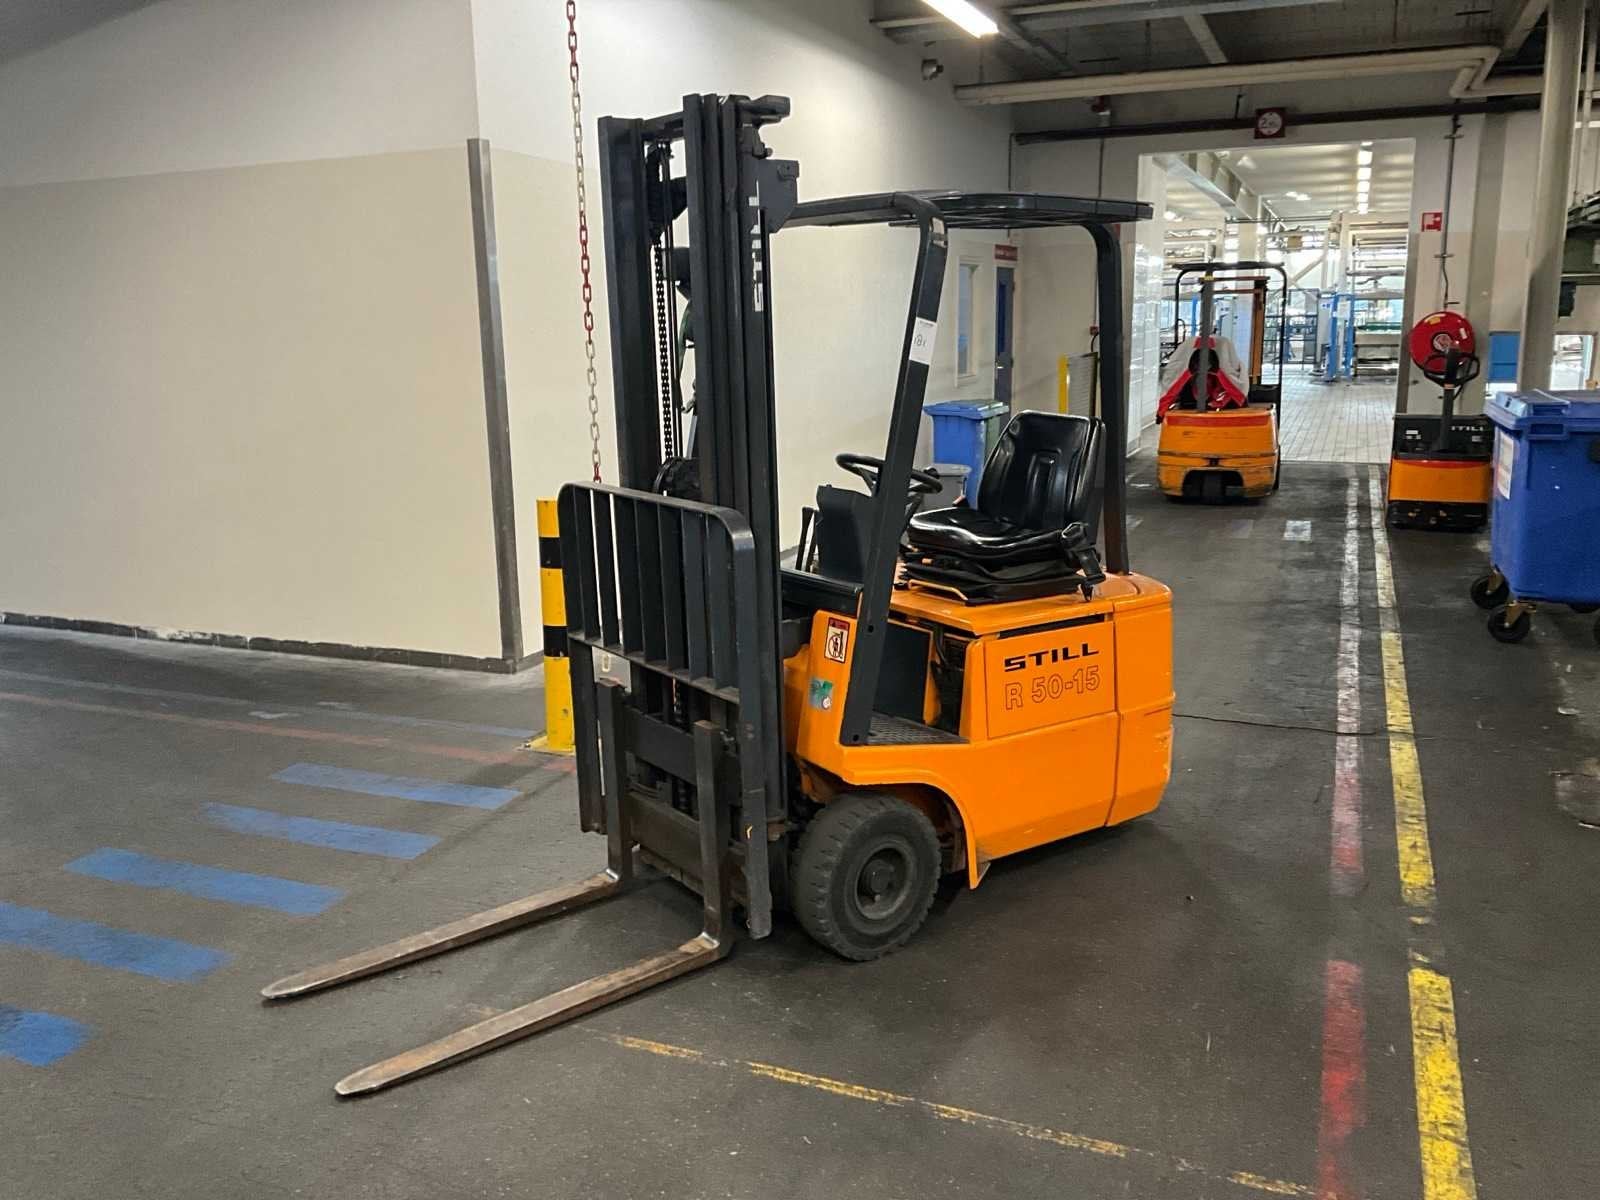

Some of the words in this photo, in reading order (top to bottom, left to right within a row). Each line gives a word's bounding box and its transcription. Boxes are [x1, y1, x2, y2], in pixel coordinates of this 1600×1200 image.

[748, 179, 764, 312] STILL
[1004, 643, 1099, 672] STILL
[1005, 682, 1023, 710] R
[1031, 665, 1100, 703] 50-15
